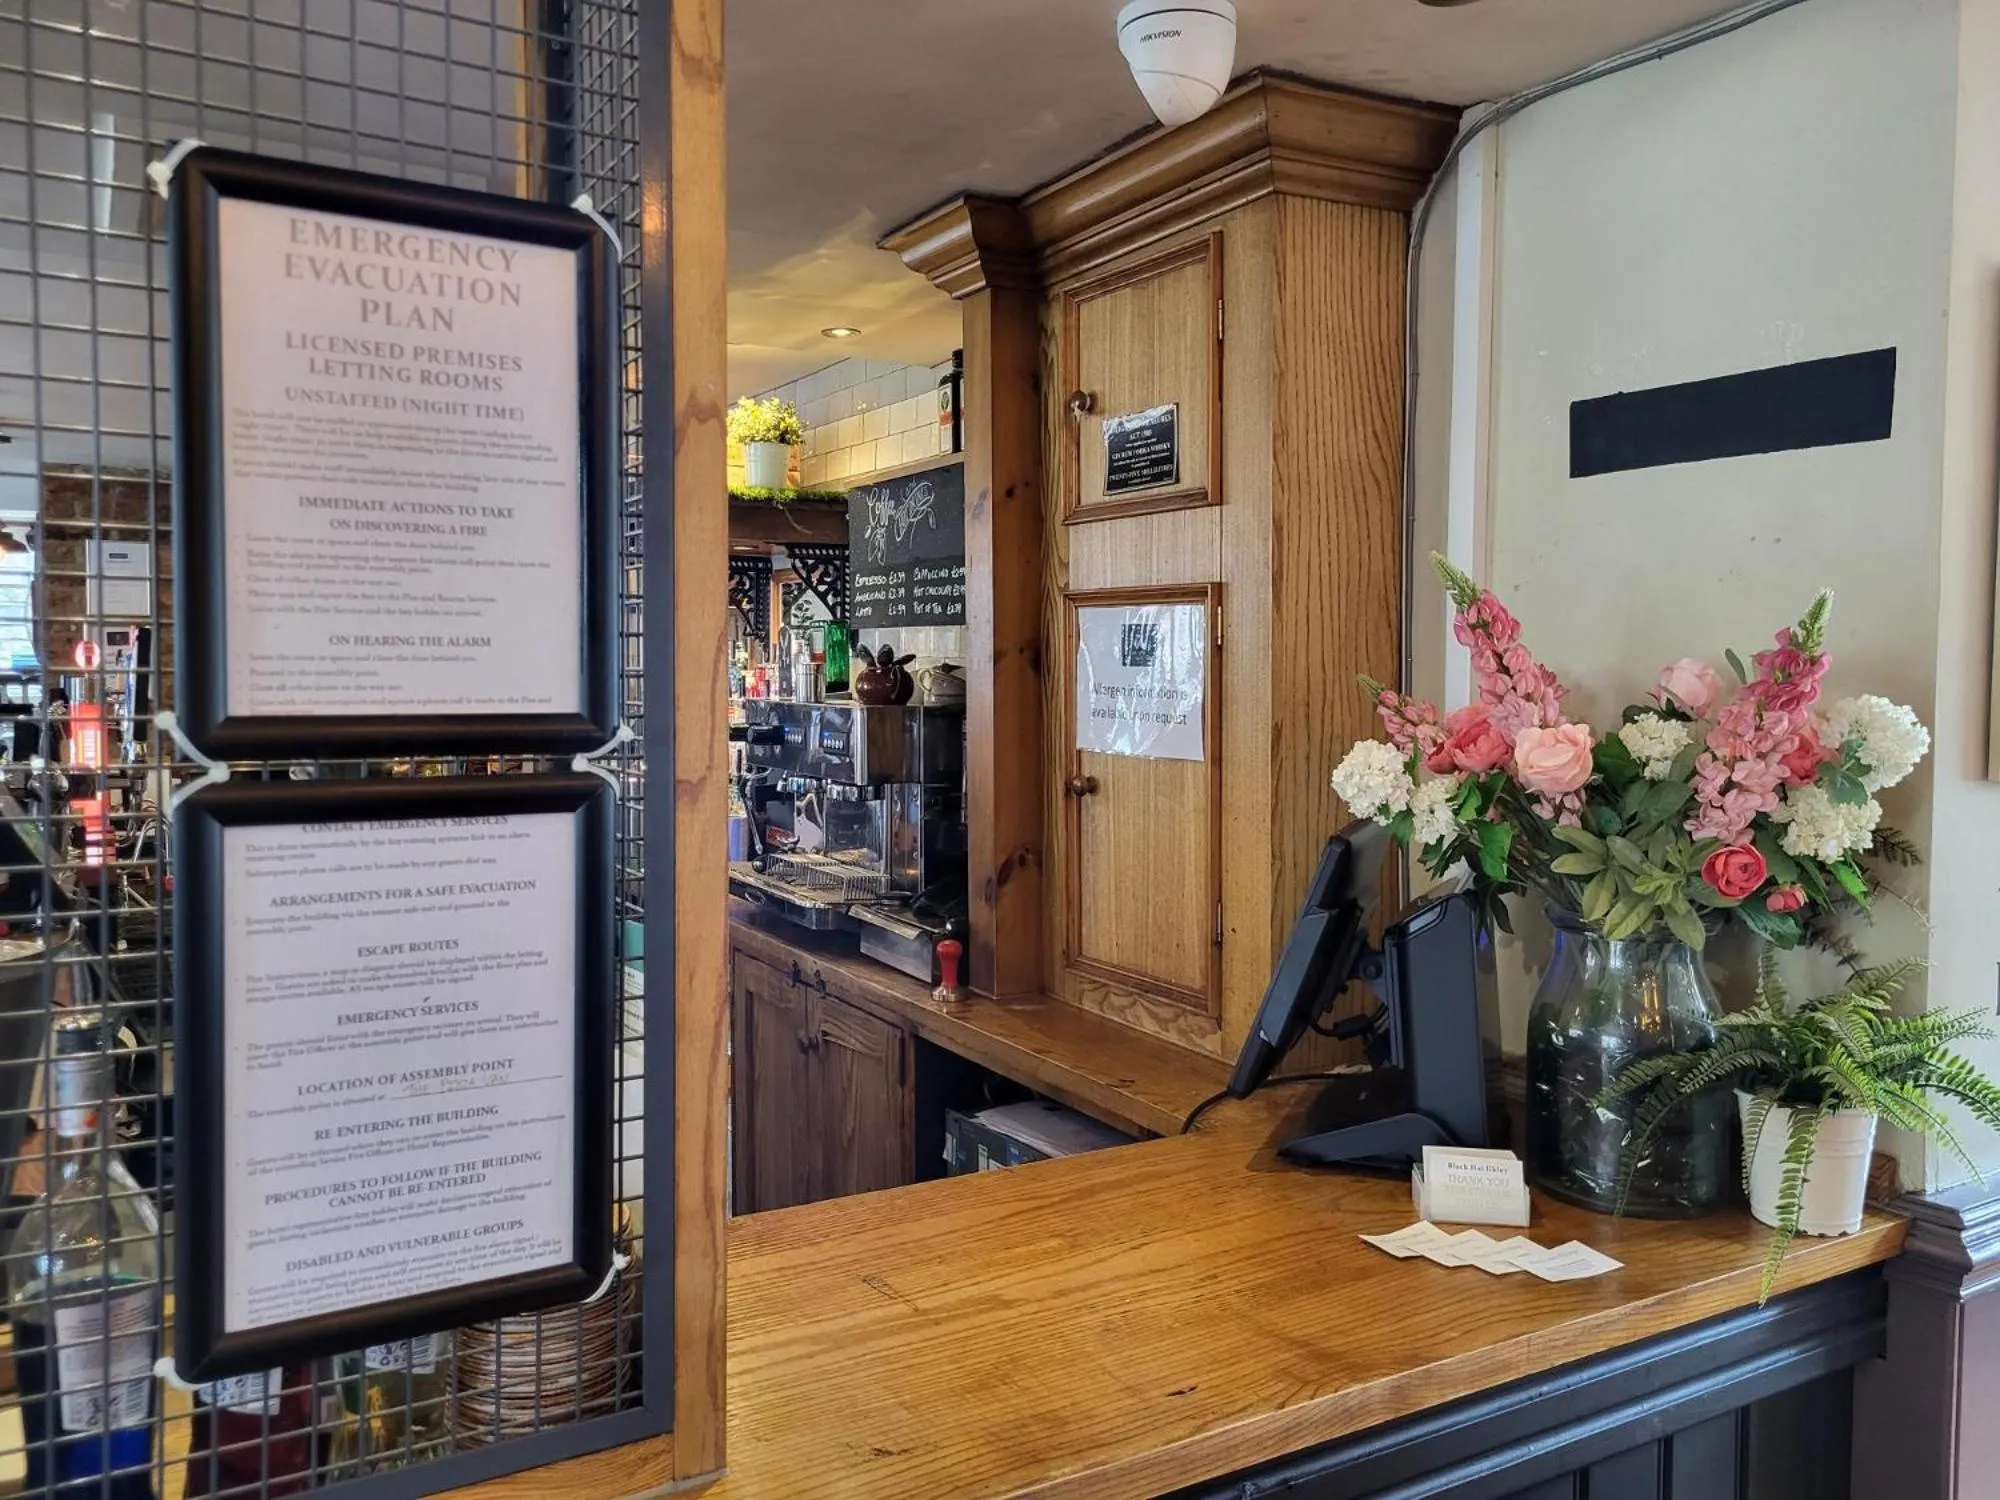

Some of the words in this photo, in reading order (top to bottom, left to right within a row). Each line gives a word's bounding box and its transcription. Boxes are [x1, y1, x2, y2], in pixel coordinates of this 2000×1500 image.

[1139, 29, 1183, 43] HIKVISION
[289, 216, 519, 274] EMERGENCY
[284, 252, 522, 308] EVACUATION
[359, 297, 455, 334] PLAN
[285, 331, 405, 362] LICENSED
[412, 344, 523, 373] PREMISES
[308, 356, 412, 385] LETTING
[419, 369, 504, 393] ROOMS
[284, 386, 398, 412] UNSTAFFED
[402, 397, 469, 418] (NIGHT
[474, 403, 524, 422] TIME)
[298, 495, 386, 513] IMMEDIATE
[390, 501, 454, 516] ACTIONS
[457, 505, 477, 517] TO
[481, 506, 515, 519] TAKE
[329, 518, 351, 531] ON
[354, 520, 446, 535] DISCOVERING
[450, 524, 458, 536] A
[460, 524, 488, 537] FIRE
[328, 634, 350, 646] ON
[353, 634, 415, 647] HEARING
[419, 635, 444, 647] THE
[447, 635, 491, 647] ALARM
[1127, 684, 1178, 701] informtion
[269, 890, 382, 908] ARRANGEMENTS
[385, 887, 413, 900] FOR
[414, 887, 424, 898] A
[427, 884, 456, 897] SAFE
[459, 879, 537, 895] EVACUATION
[358, 943, 405, 958] ESCAPE
[409, 938, 460, 954] ROUTES
[337, 1010, 419, 1026] EMERGENCY
[421, 1000, 480, 1015] SERVICES
[297, 1076, 375, 1096] LOCATION
[378, 1073, 396, 1085] OF
[400, 1064, 469, 1084] ASSEMBLY
[472, 1057, 517, 1073] POINT
[407, 1113, 436, 1129] THE
[437, 1105, 500, 1121] BUILDING
[264, 1182, 357, 1206] PROCEDURES
[361, 1177, 379, 1190] TO
[382, 1167, 437, 1187] FOLLOW
[439, 1163, 452, 1176] IF
[453, 1160, 480, 1175] THE
[482, 1151, 543, 1169] BUILDING
[1446, 1173, 1484, 1186] THANK
[1486, 1176, 1510, 1187] YOU
[329, 1189, 385, 1208] CANNOT
[388, 1186, 405, 1198] BE
[285, 1250, 355, 1272] DISABLED
[357, 1244, 386, 1259] AND
[388, 1229, 471, 1255] VULNERABLE
[473, 1217, 525, 1238] GROUPS
